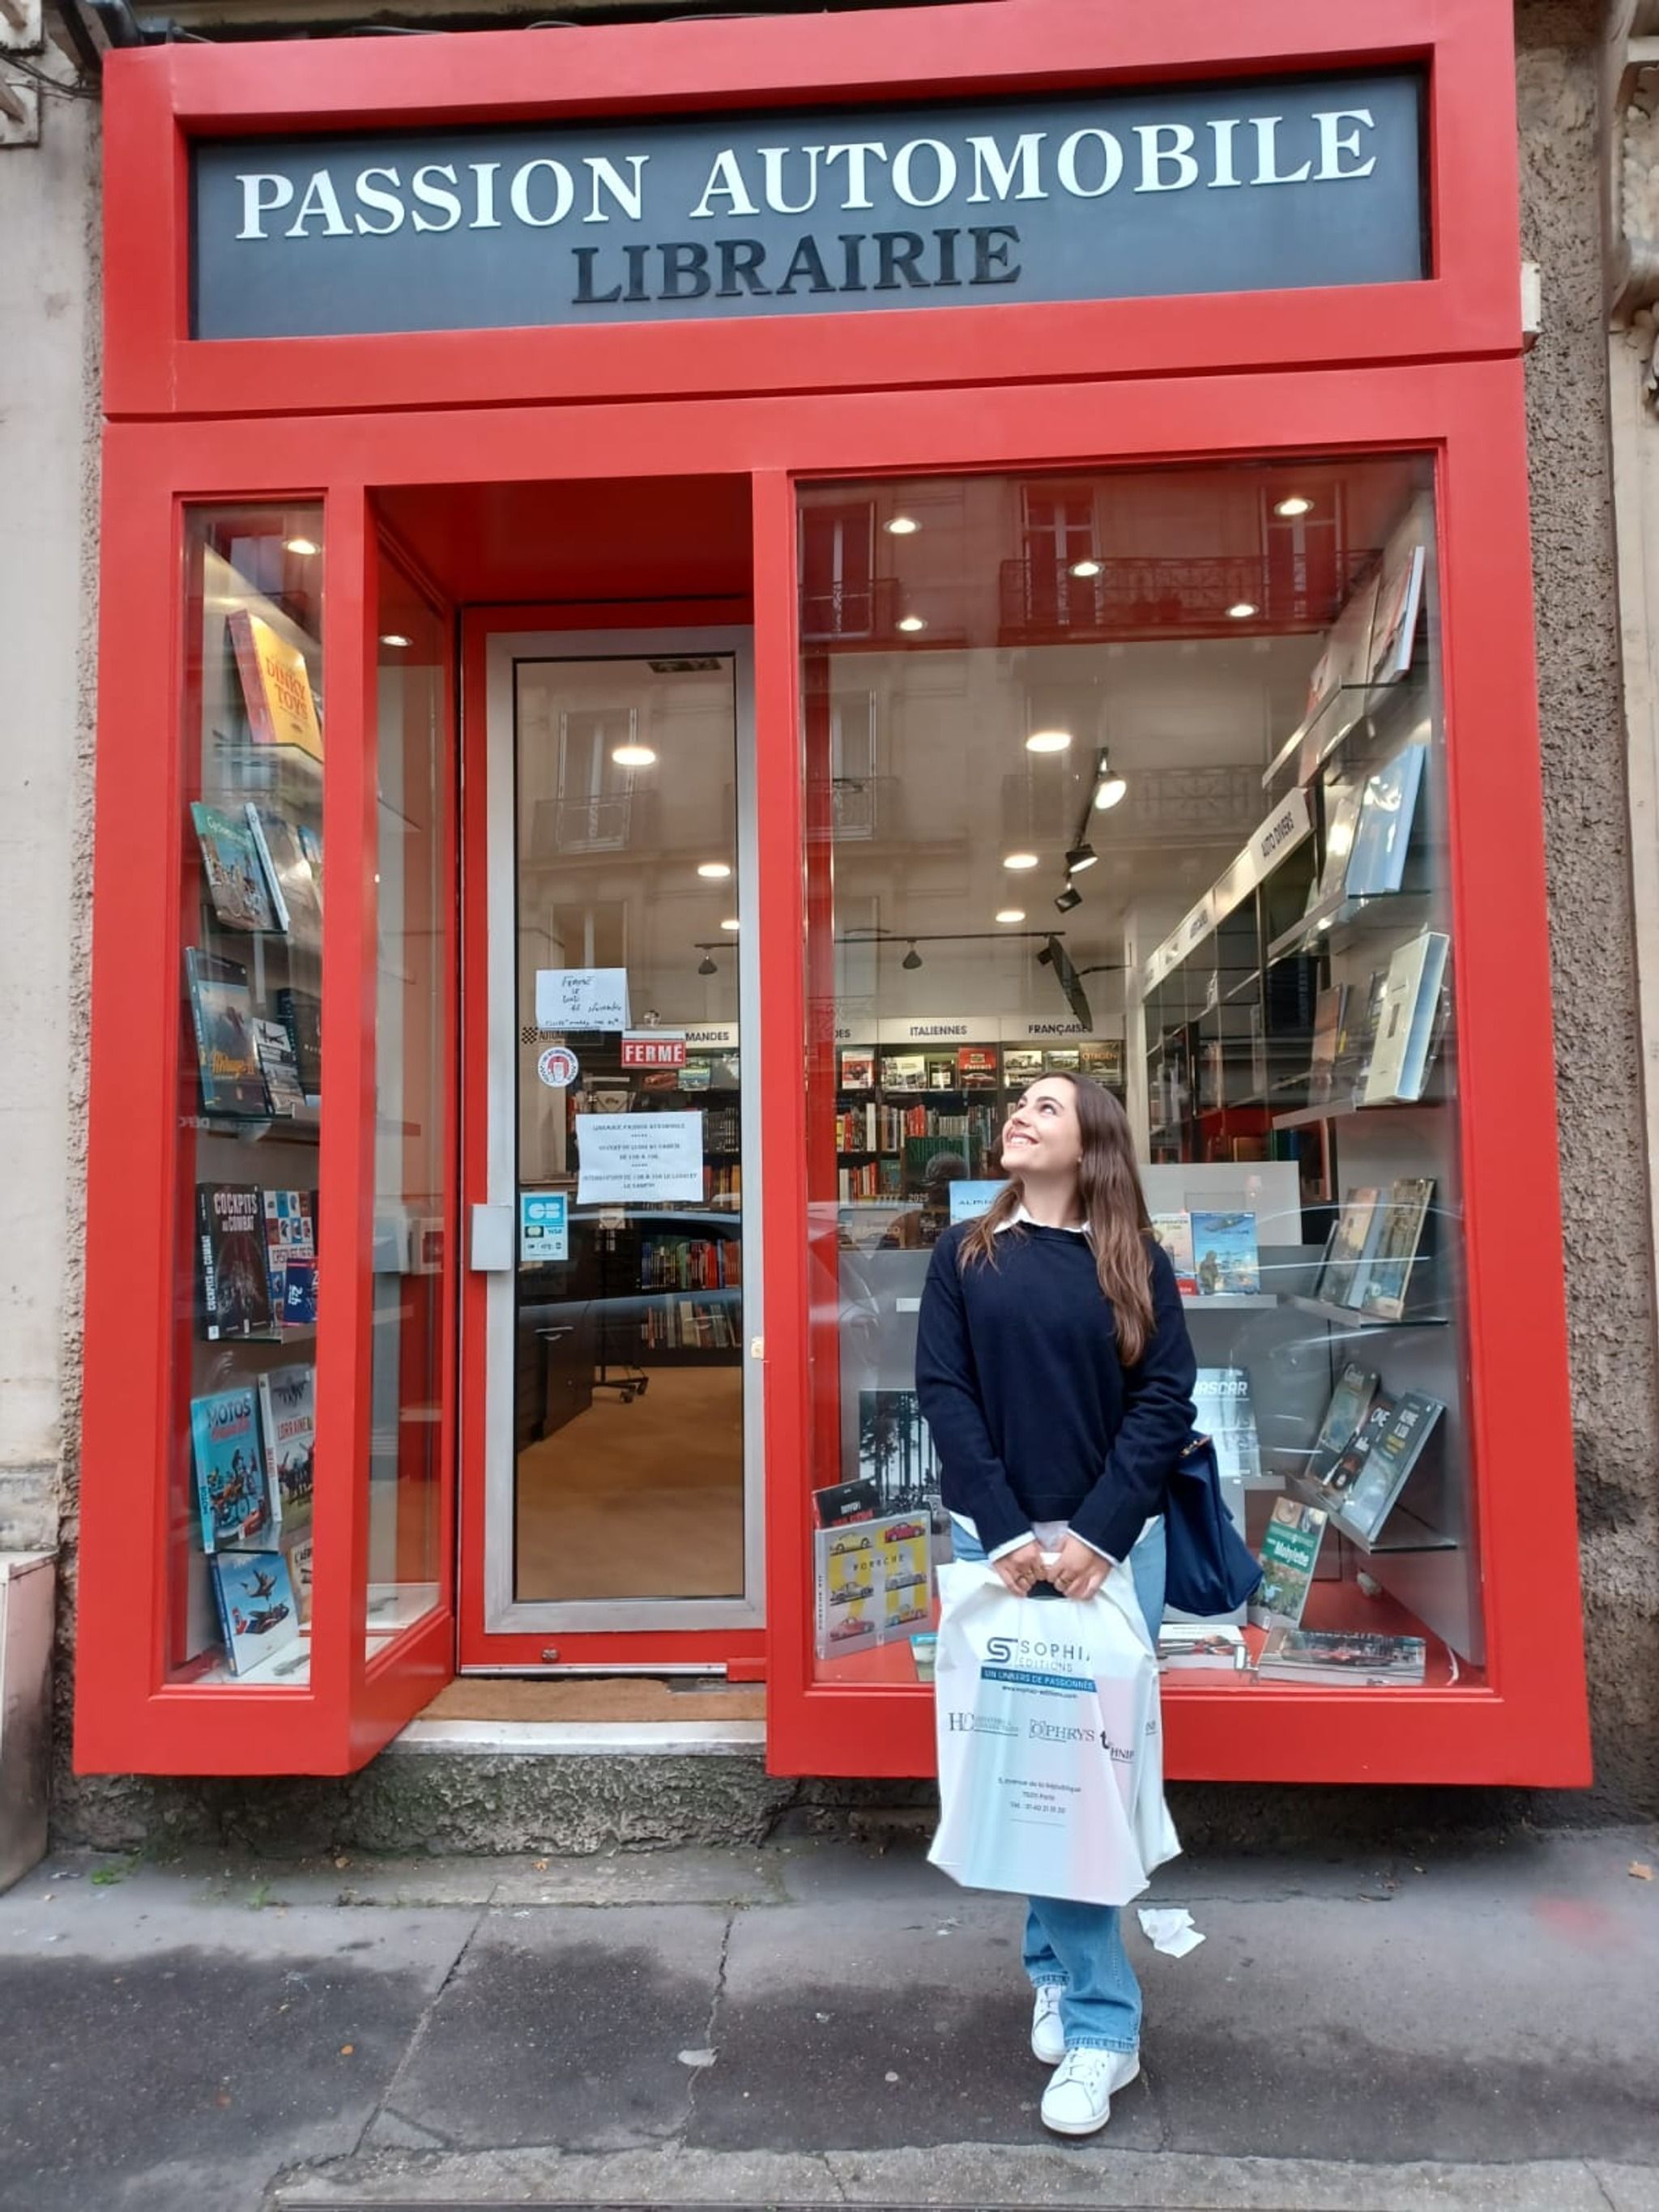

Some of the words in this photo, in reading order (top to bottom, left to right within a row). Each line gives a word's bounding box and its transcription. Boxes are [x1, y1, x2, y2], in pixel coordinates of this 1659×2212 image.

[236, 155, 650, 241] PASSION
[689, 109, 1377, 219] AUTOMOBILE
[571, 224, 1022, 305] LIBRAIRIE
[266, 657, 306, 700] DINKY
[275, 684, 308, 719] TOYS
[1260, 833, 1276, 859] AUTO
[910, 1025, 968, 1037] ITALIENNES
[625, 1043, 683, 1063] FERMÉ
[214, 1193, 258, 1215] COCKPITS
[207, 1399, 252, 1428] MOTOS
[854, 1554, 905, 1571] PORSCHE
[1031, 1675, 1043, 1684] DE
